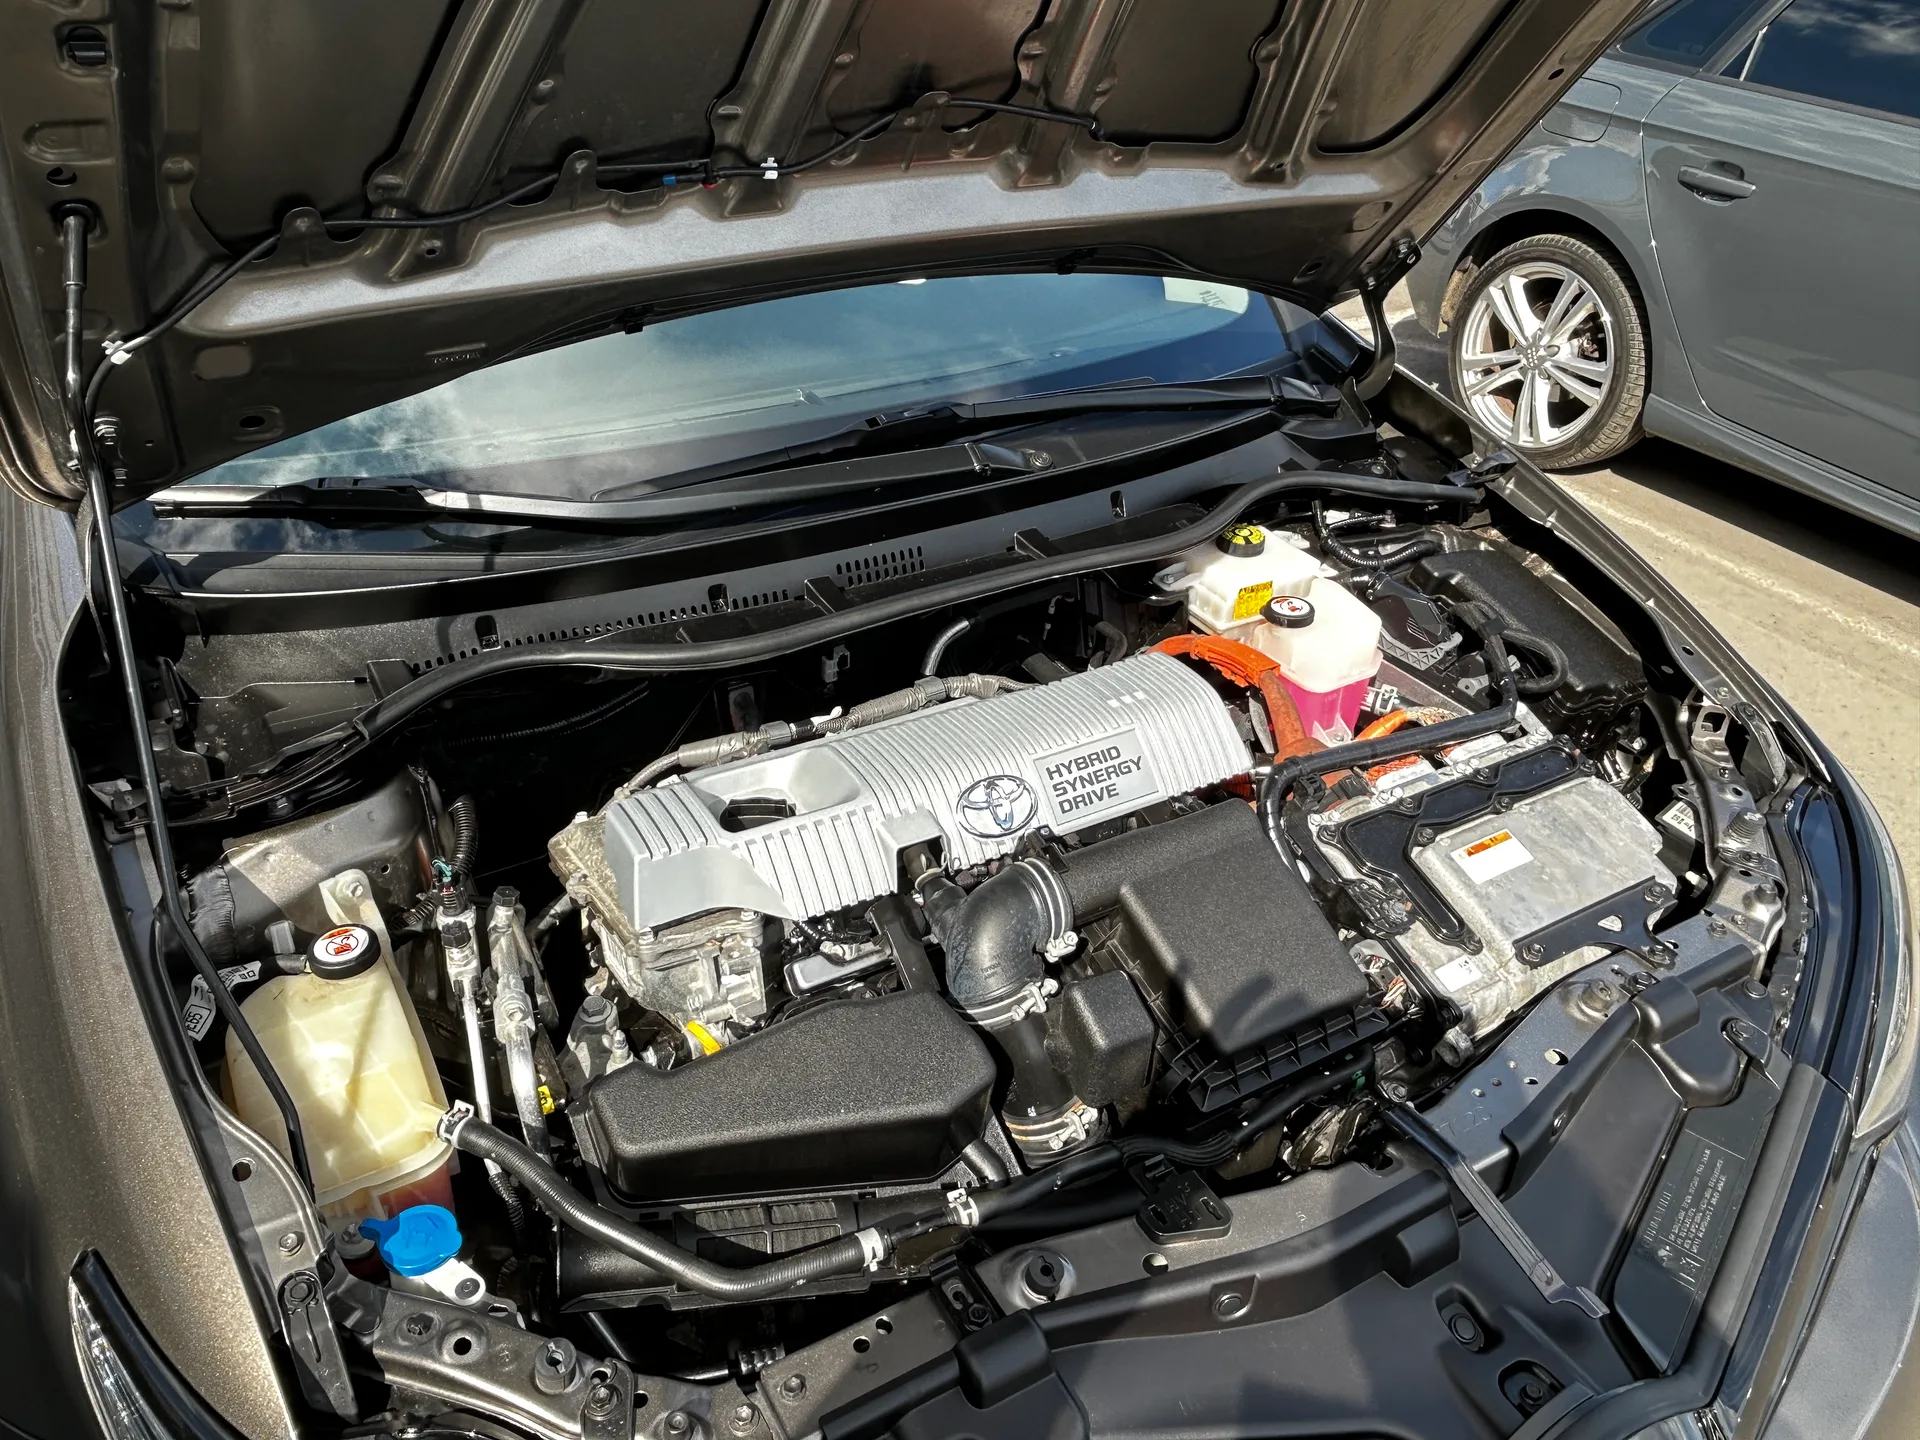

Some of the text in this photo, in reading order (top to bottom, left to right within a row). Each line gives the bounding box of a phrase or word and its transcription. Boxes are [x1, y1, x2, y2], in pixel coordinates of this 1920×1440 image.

[1045, 745, 1122, 781] HYBRID
[1052, 755, 1142, 798] SYNERGY
[1058, 783, 1120, 814] DRIVE
